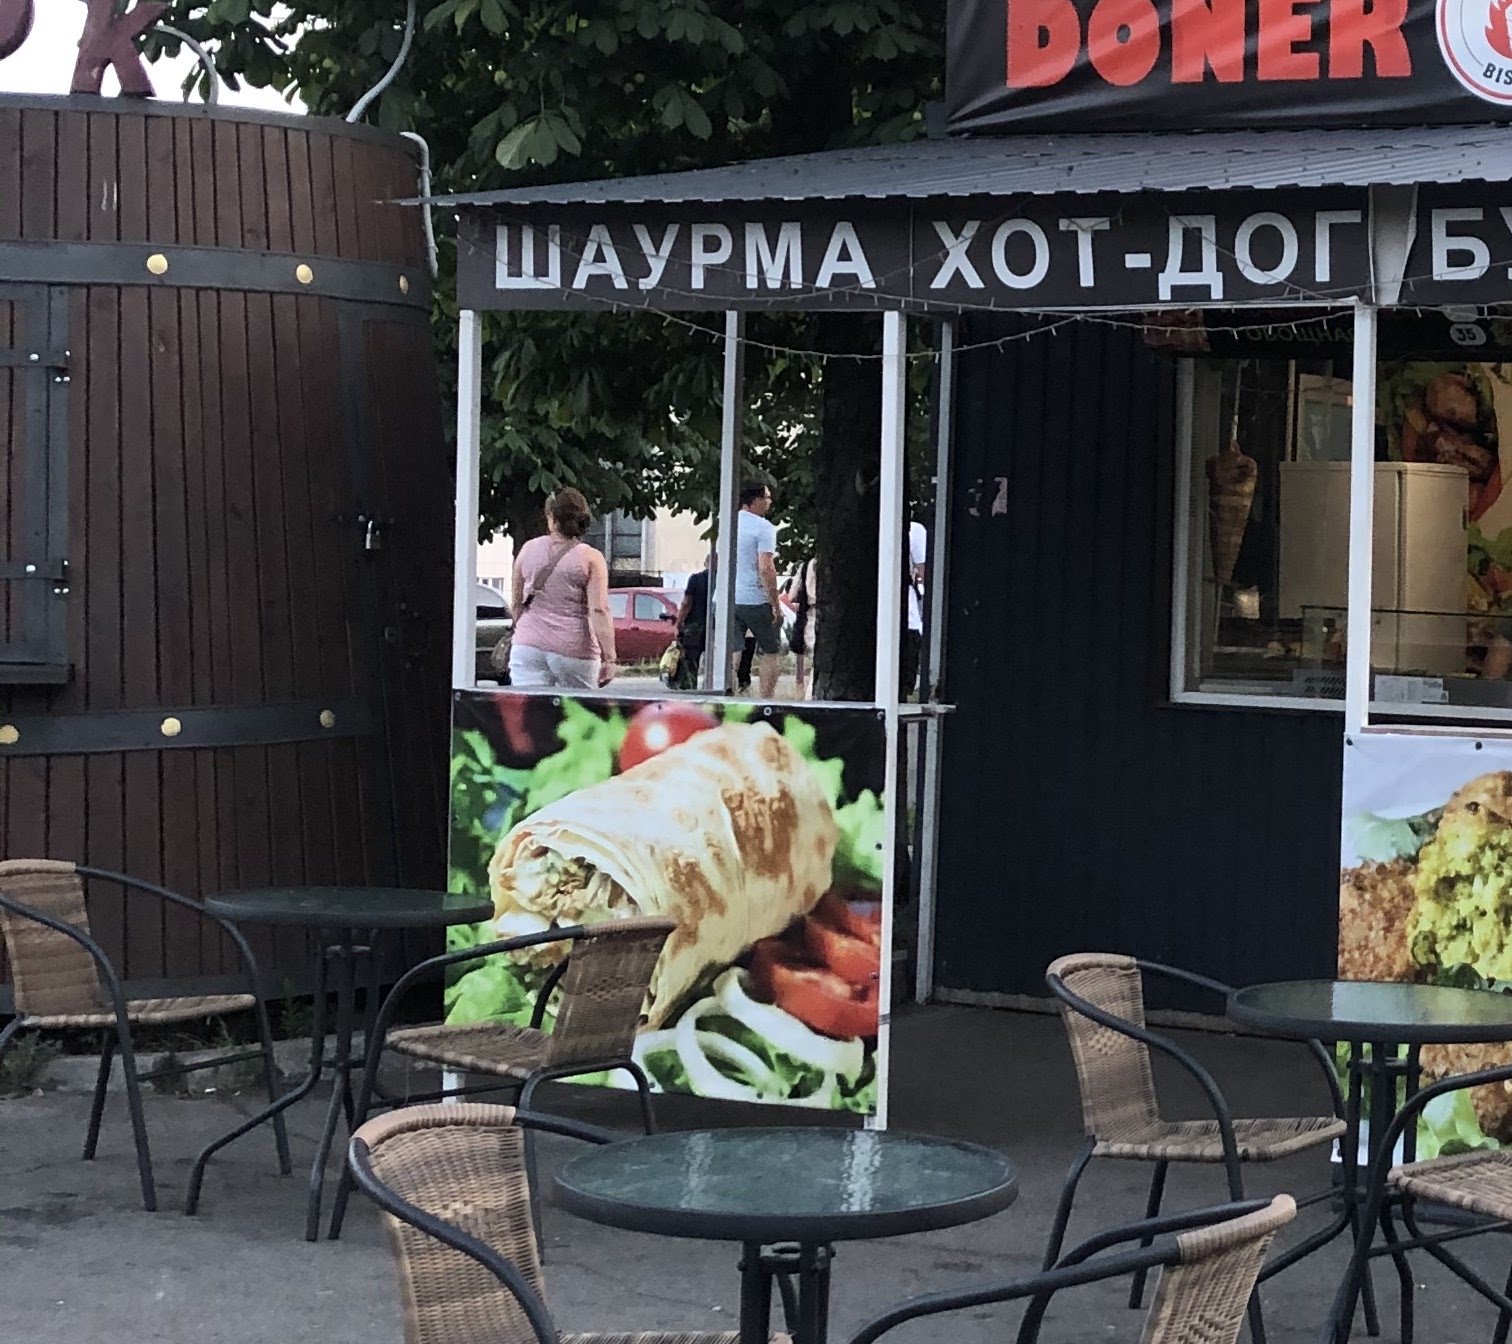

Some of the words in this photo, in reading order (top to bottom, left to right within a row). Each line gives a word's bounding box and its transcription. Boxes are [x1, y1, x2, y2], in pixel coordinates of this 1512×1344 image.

[496, 221, 877, 289] ШАУРМА
[930, 210, 1363, 301] ХОТ-ДОГ
[1455, 327, 1477, 341] 35
